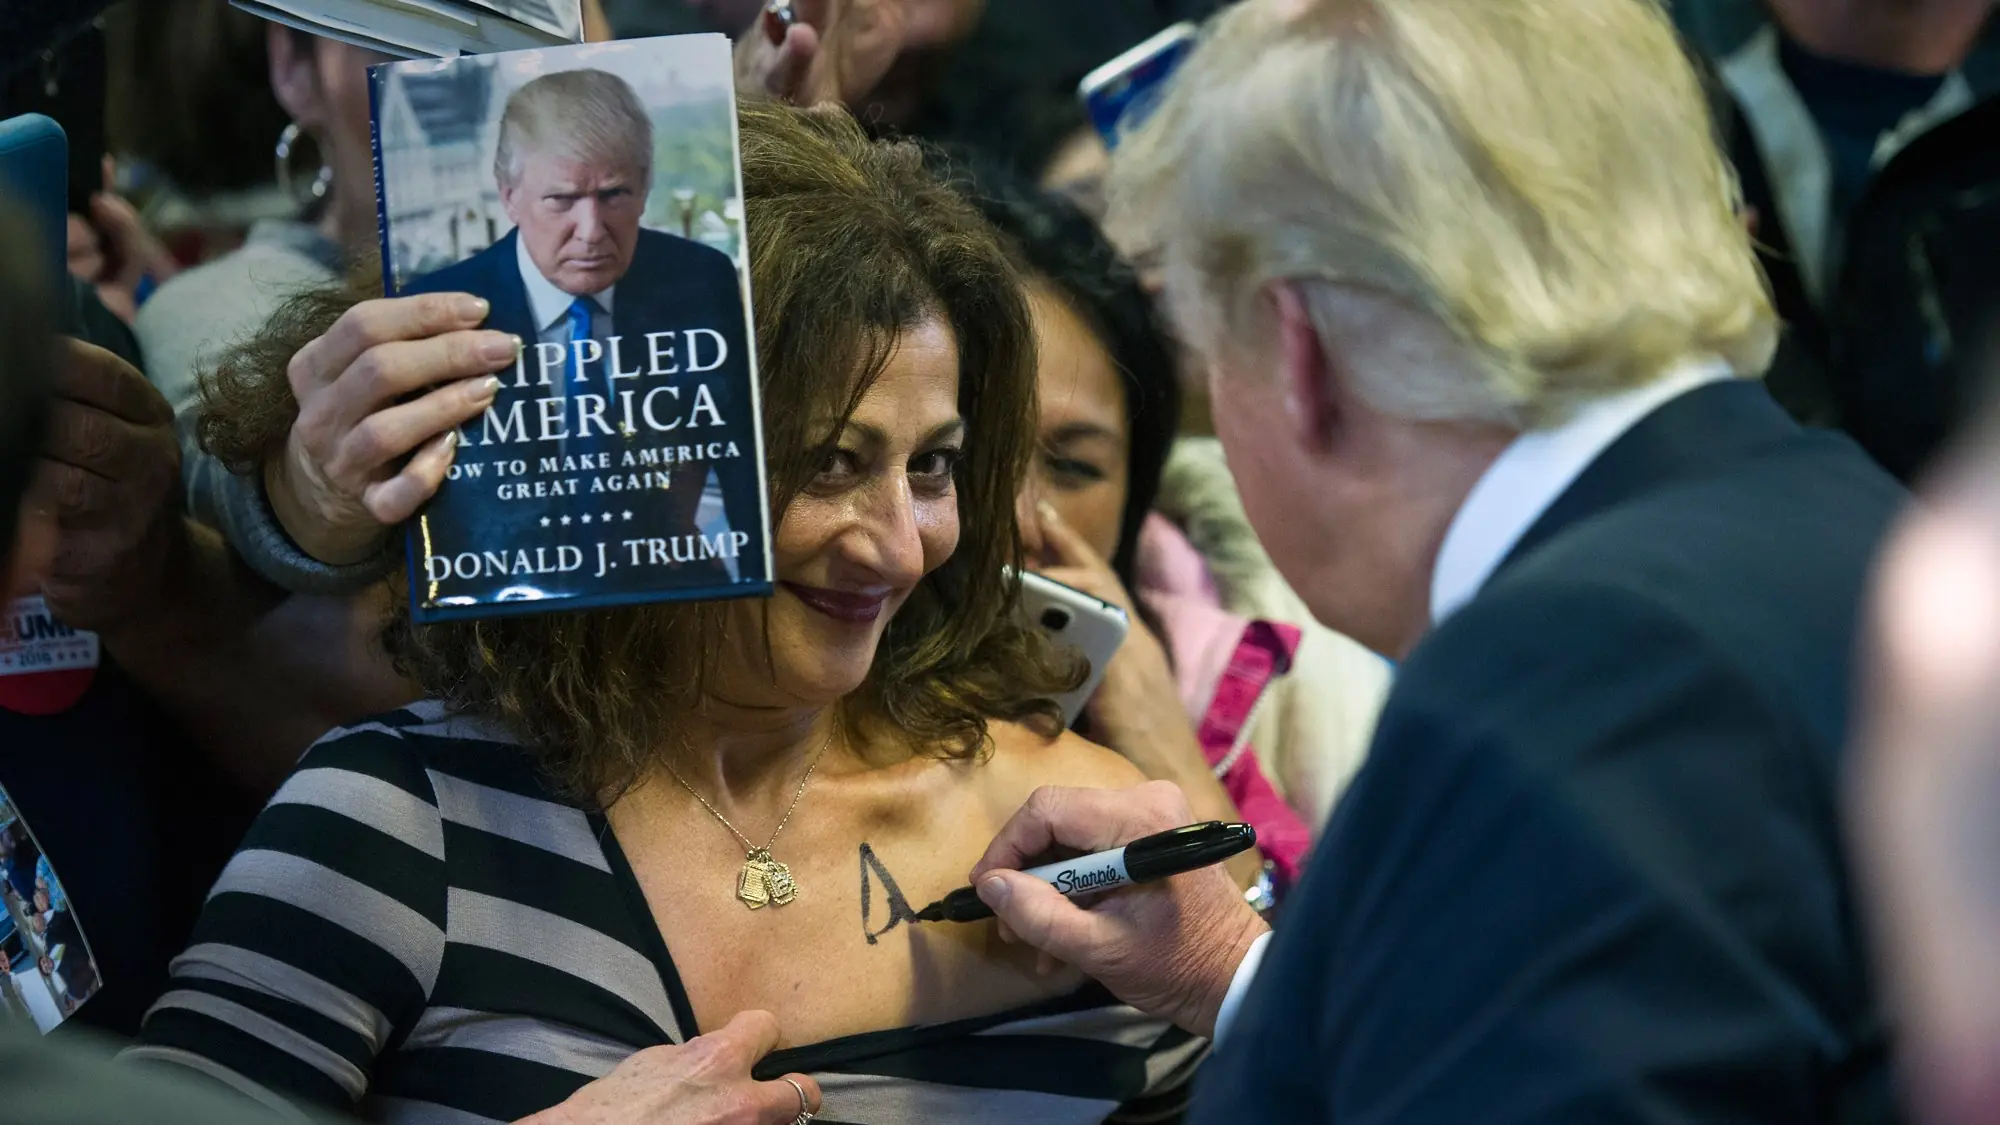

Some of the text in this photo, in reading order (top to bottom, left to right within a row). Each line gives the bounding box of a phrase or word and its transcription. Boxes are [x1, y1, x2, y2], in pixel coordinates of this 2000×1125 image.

[495, 328, 728, 389] IPPLED
[446, 441, 741, 481] OW TO MAKE AMERICA
[497, 471, 671, 500] GREAT AGAIN
[427, 531, 749, 581] DONALD J. TRUMP
[1050, 864, 1122, 894] Sharpie
